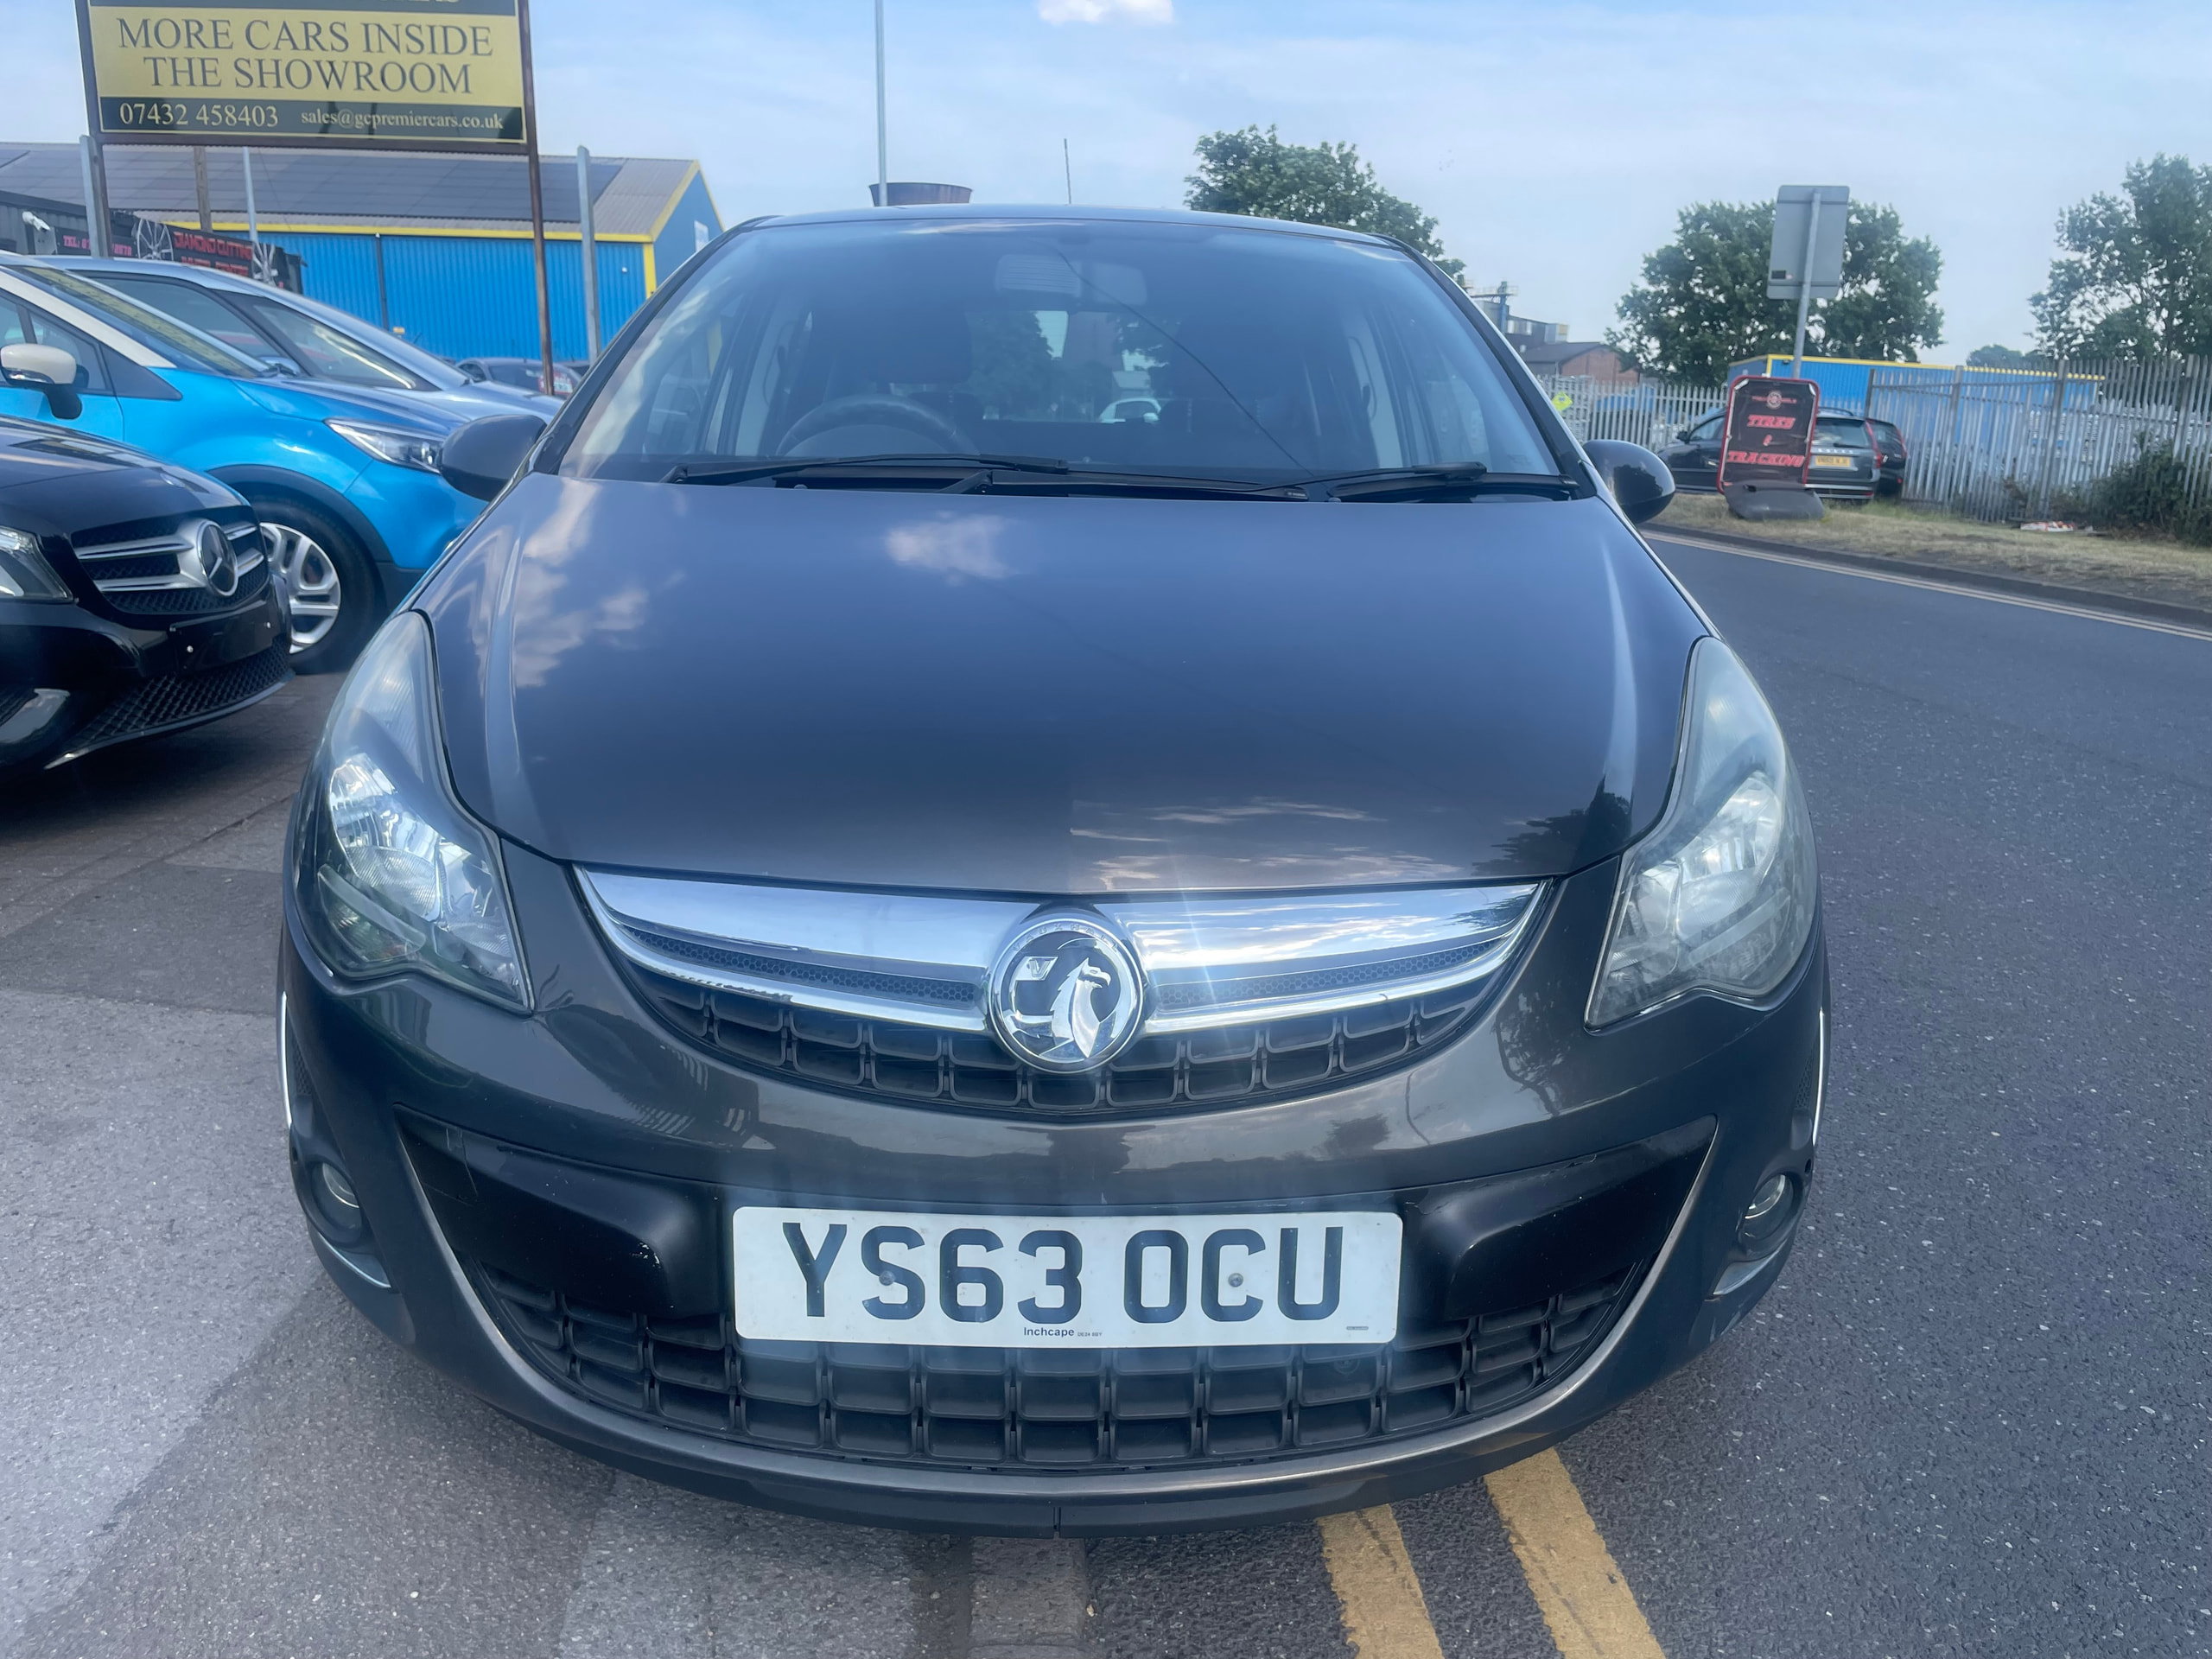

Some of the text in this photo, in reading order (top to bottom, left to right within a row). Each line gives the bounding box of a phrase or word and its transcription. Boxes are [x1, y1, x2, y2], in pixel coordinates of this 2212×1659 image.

[117, 17, 494, 56] MORE CARS INSIDE
[143, 56, 473, 94] THE SHOWROOM
[119, 102, 505, 130] 07432 458403 sales@gcpremiercars.co.uk
[1013, 923, 1118, 952] VAUXHALL
[782, 1222, 1344, 1325] YS63 OCU
[1023, 1327, 1075, 1338] Inchcape
